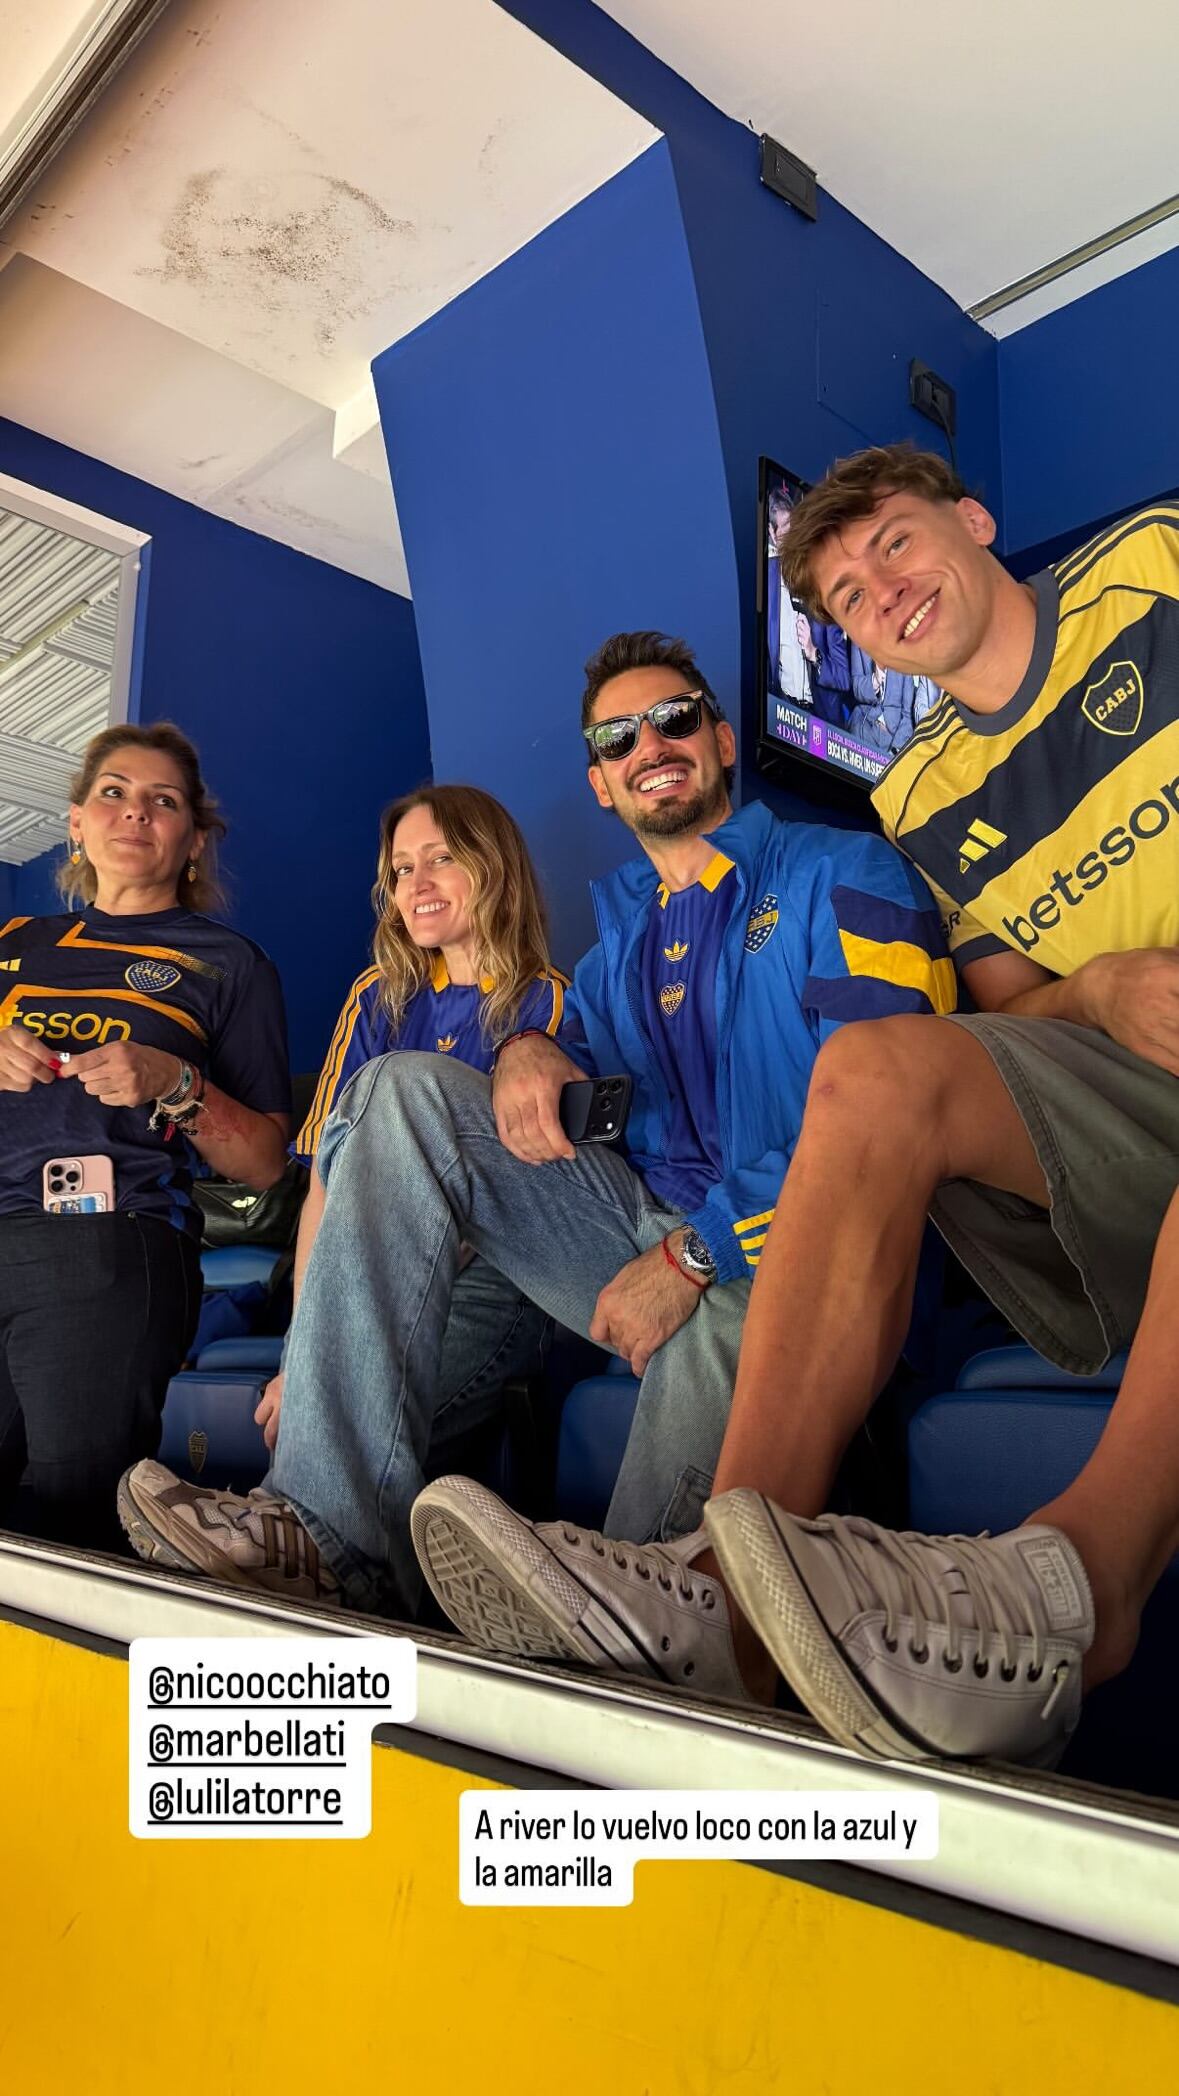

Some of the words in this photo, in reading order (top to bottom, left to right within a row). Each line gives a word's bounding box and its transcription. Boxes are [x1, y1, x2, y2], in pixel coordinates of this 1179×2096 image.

[1095, 678, 1136, 721] CABJ
[776, 704, 807, 731] MATCH
[827, 740, 842, 760] BOCA
[0, 1004, 131, 1044] tsson
